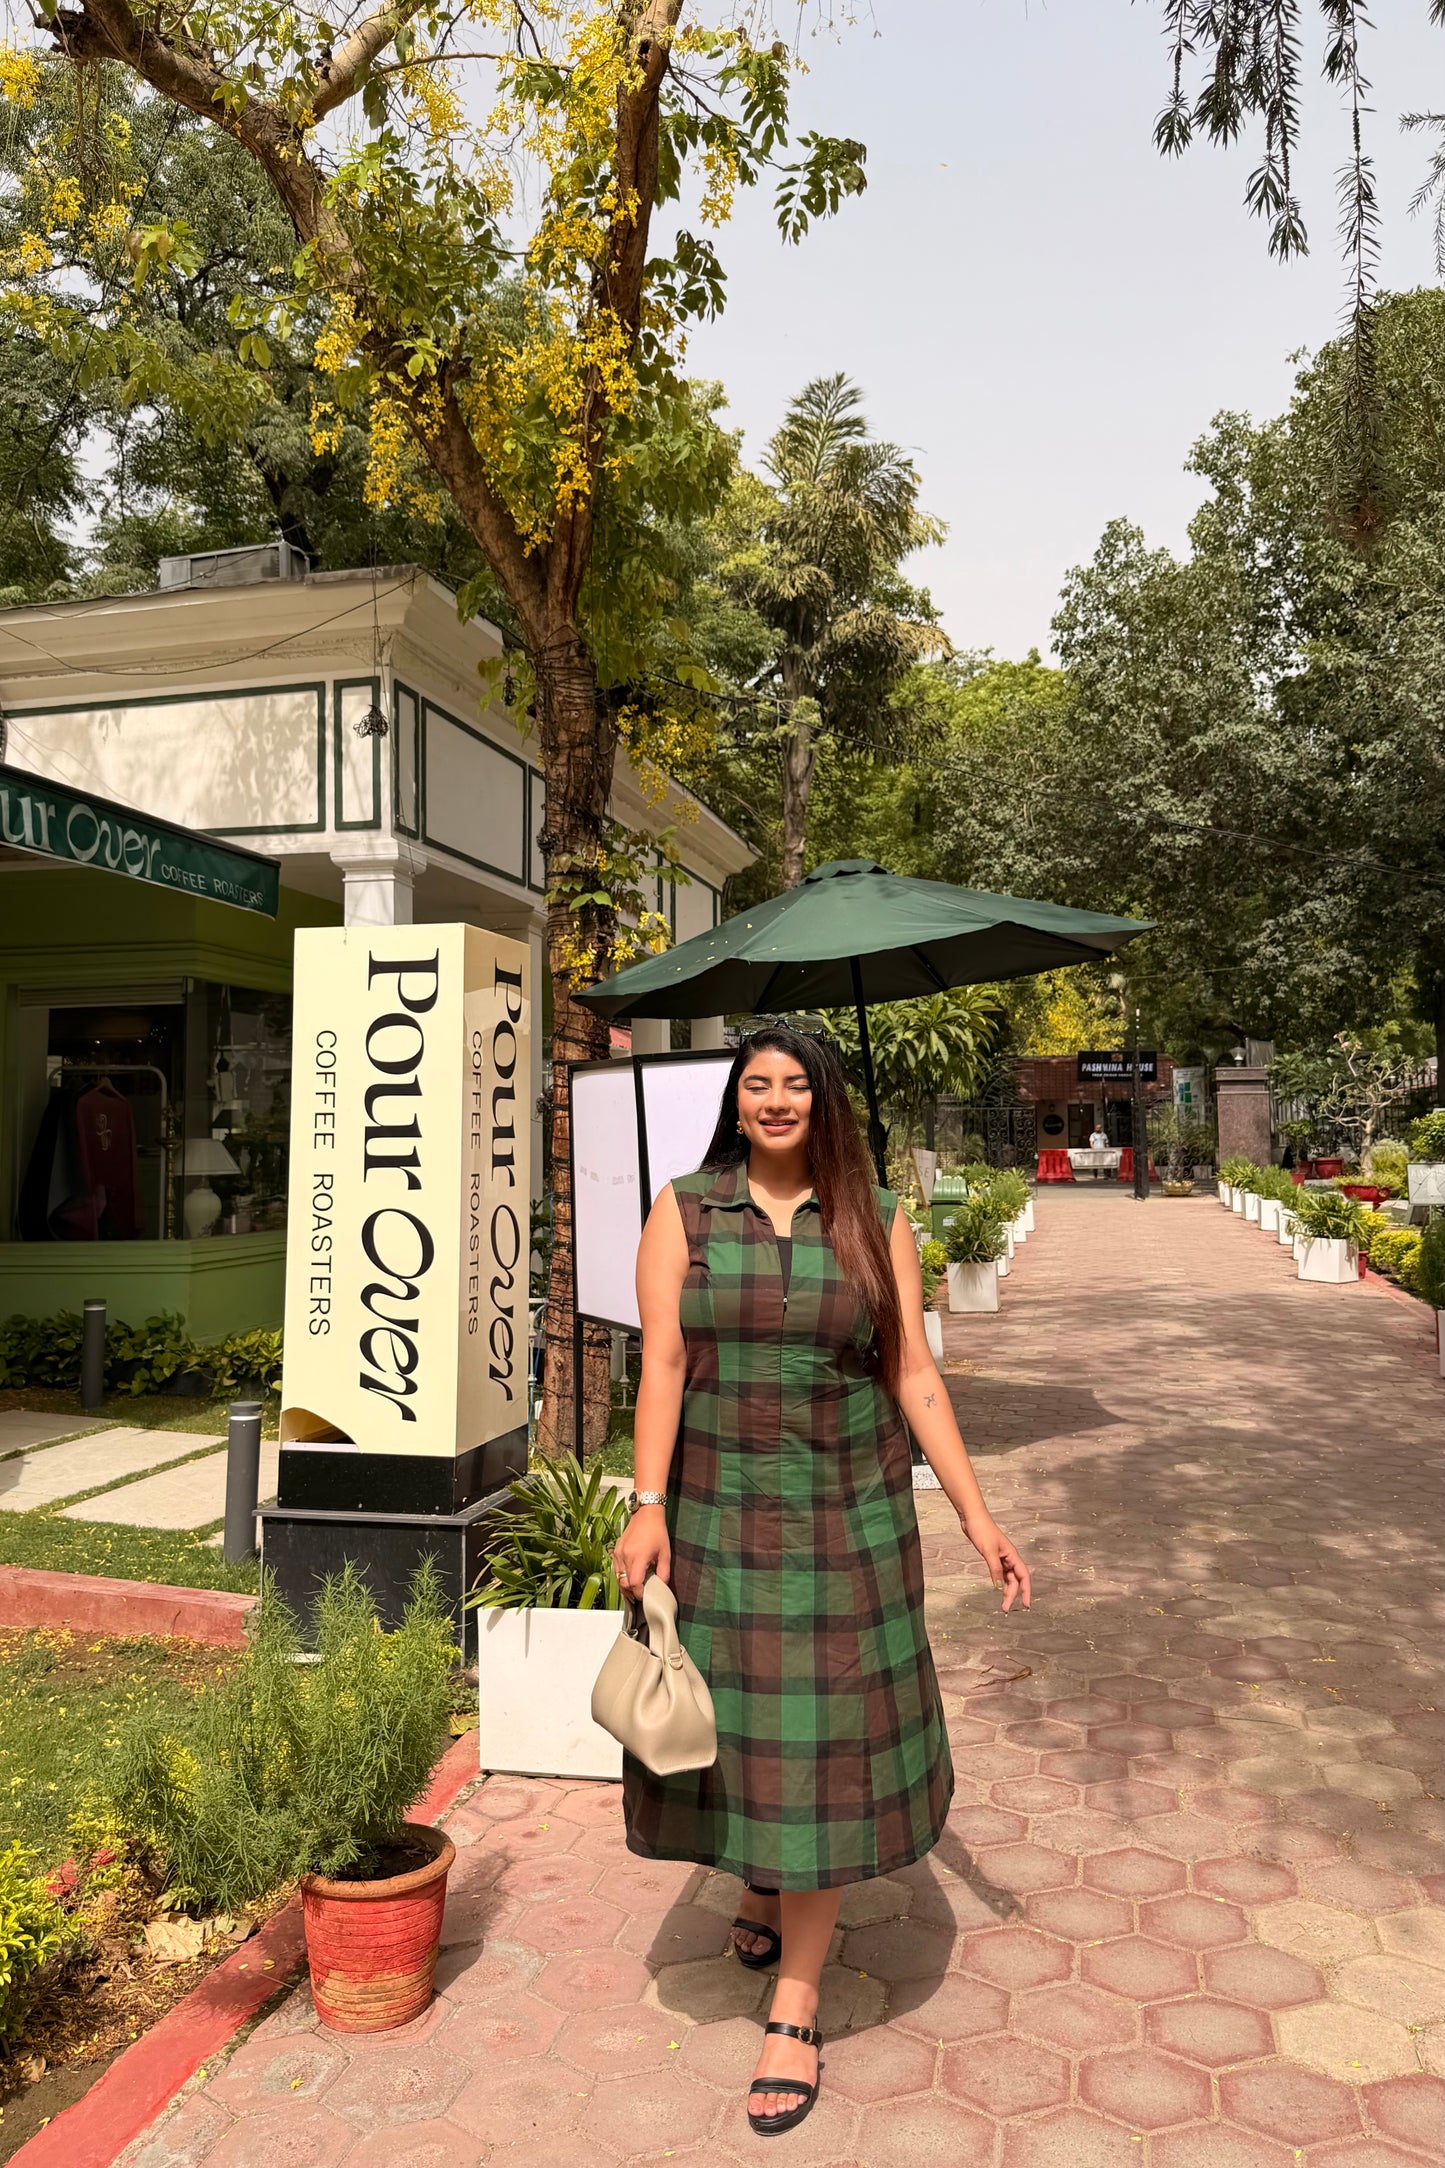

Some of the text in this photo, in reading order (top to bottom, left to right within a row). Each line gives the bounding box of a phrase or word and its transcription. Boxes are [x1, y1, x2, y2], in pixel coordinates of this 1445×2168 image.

[66, 803, 160, 878] Over
[161, 864, 265, 906] COFFEE ROASTERS
[309, 1030, 338, 1335] COFFEE ROASTERS
[359, 948, 439, 1422] Pour Over
[468, 1031, 483, 1335] COFFEE ROASTERS
[489, 957, 523, 1401] Pour Over
[1081, 1063, 1154, 1072] PASHMINA HUSE
